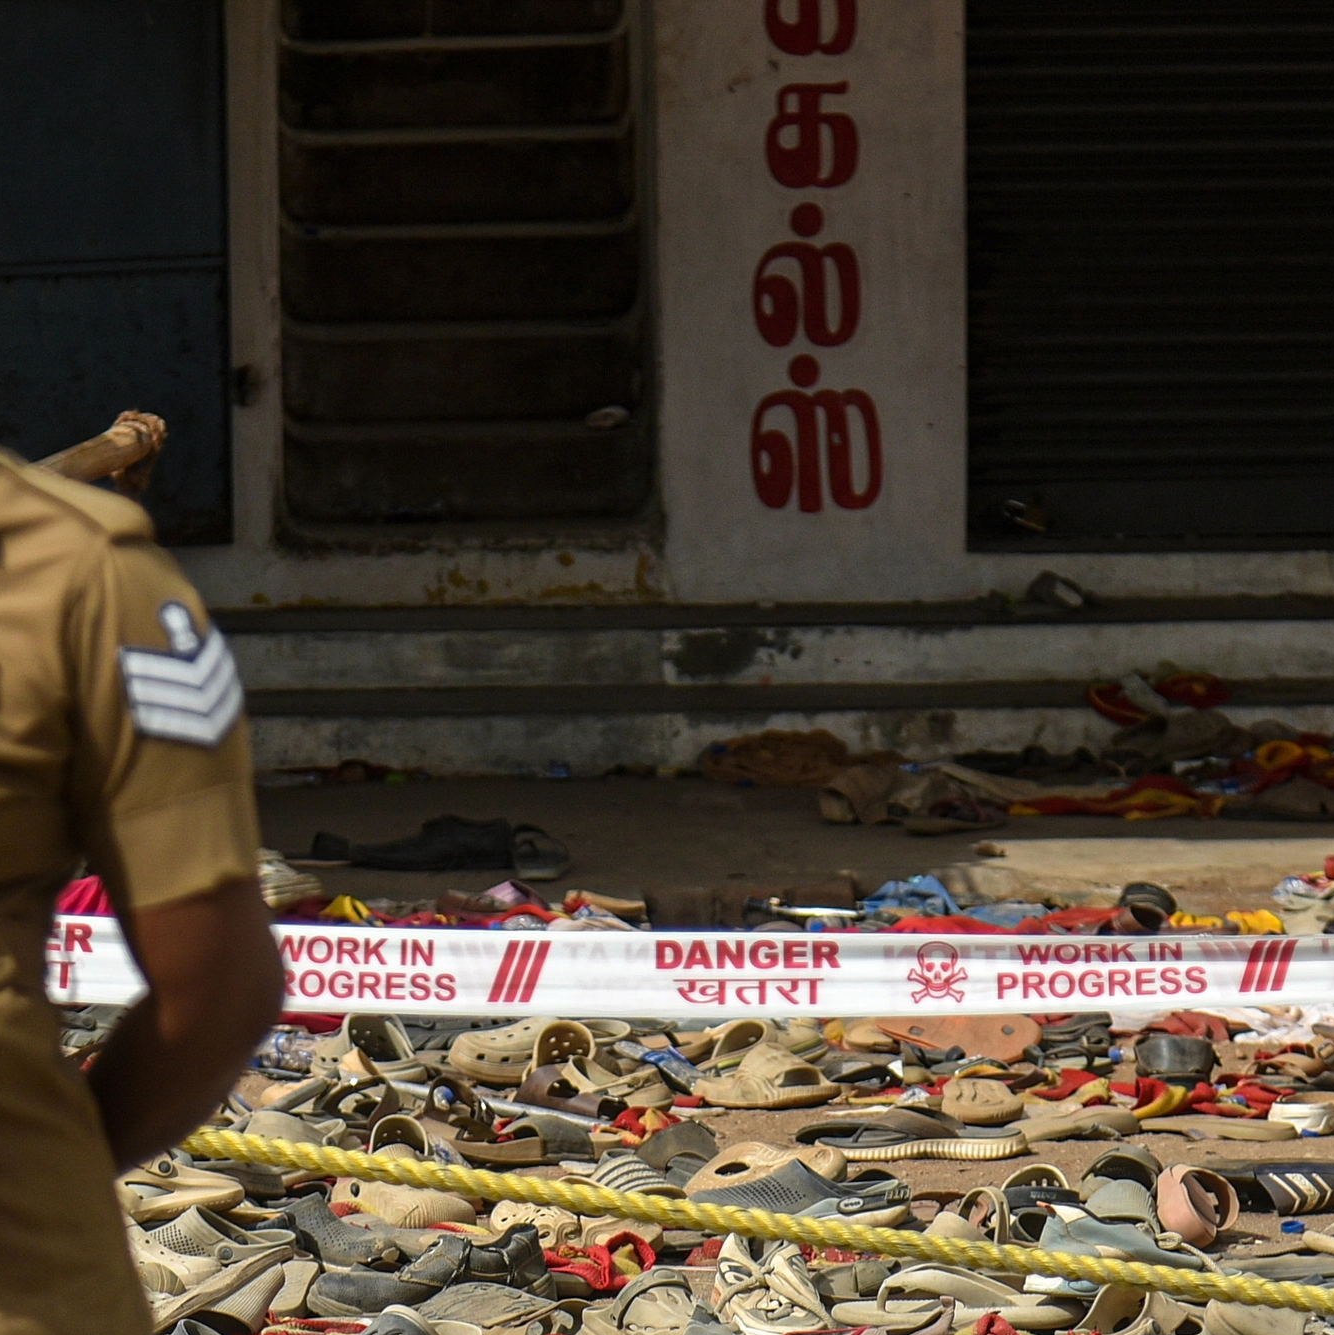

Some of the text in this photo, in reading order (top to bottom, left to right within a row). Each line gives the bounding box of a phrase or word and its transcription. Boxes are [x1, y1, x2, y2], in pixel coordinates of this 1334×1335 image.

[279, 935, 435, 967] WORK IN
[655, 939, 840, 970] DANGER
[1017, 942, 1184, 966] WORK IN
[284, 969, 457, 1002] ROGRESS
[673, 977, 825, 1006] खतरा
[996, 966, 1208, 1000] PROGRESS
